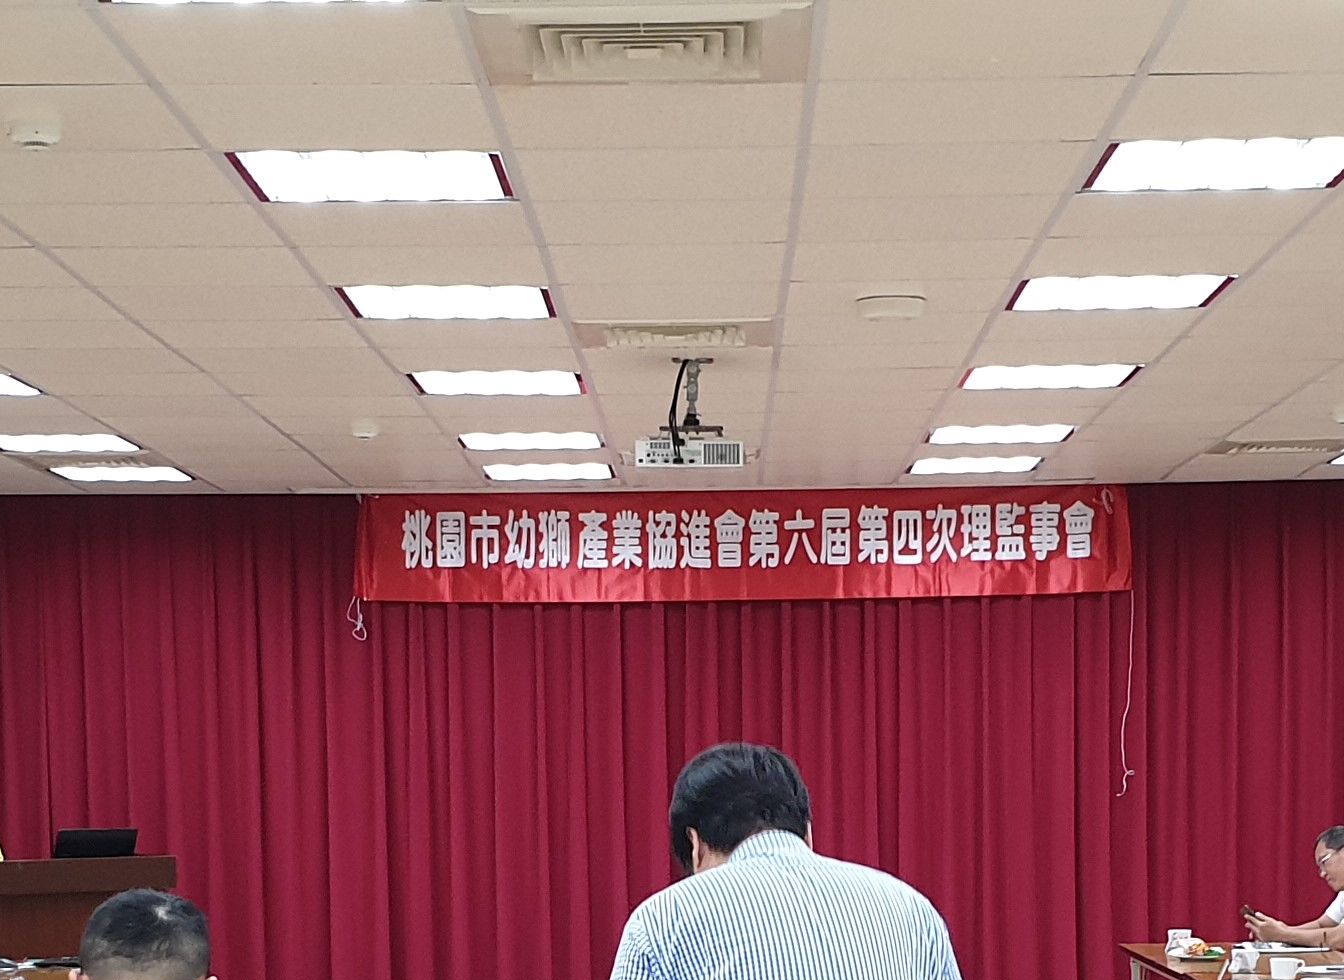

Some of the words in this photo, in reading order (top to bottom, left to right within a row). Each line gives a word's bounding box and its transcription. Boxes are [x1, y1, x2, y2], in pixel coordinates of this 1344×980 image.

[402, 501, 1095, 570] 桃園市幼獅產業協進會第六屆第四次理監事會
